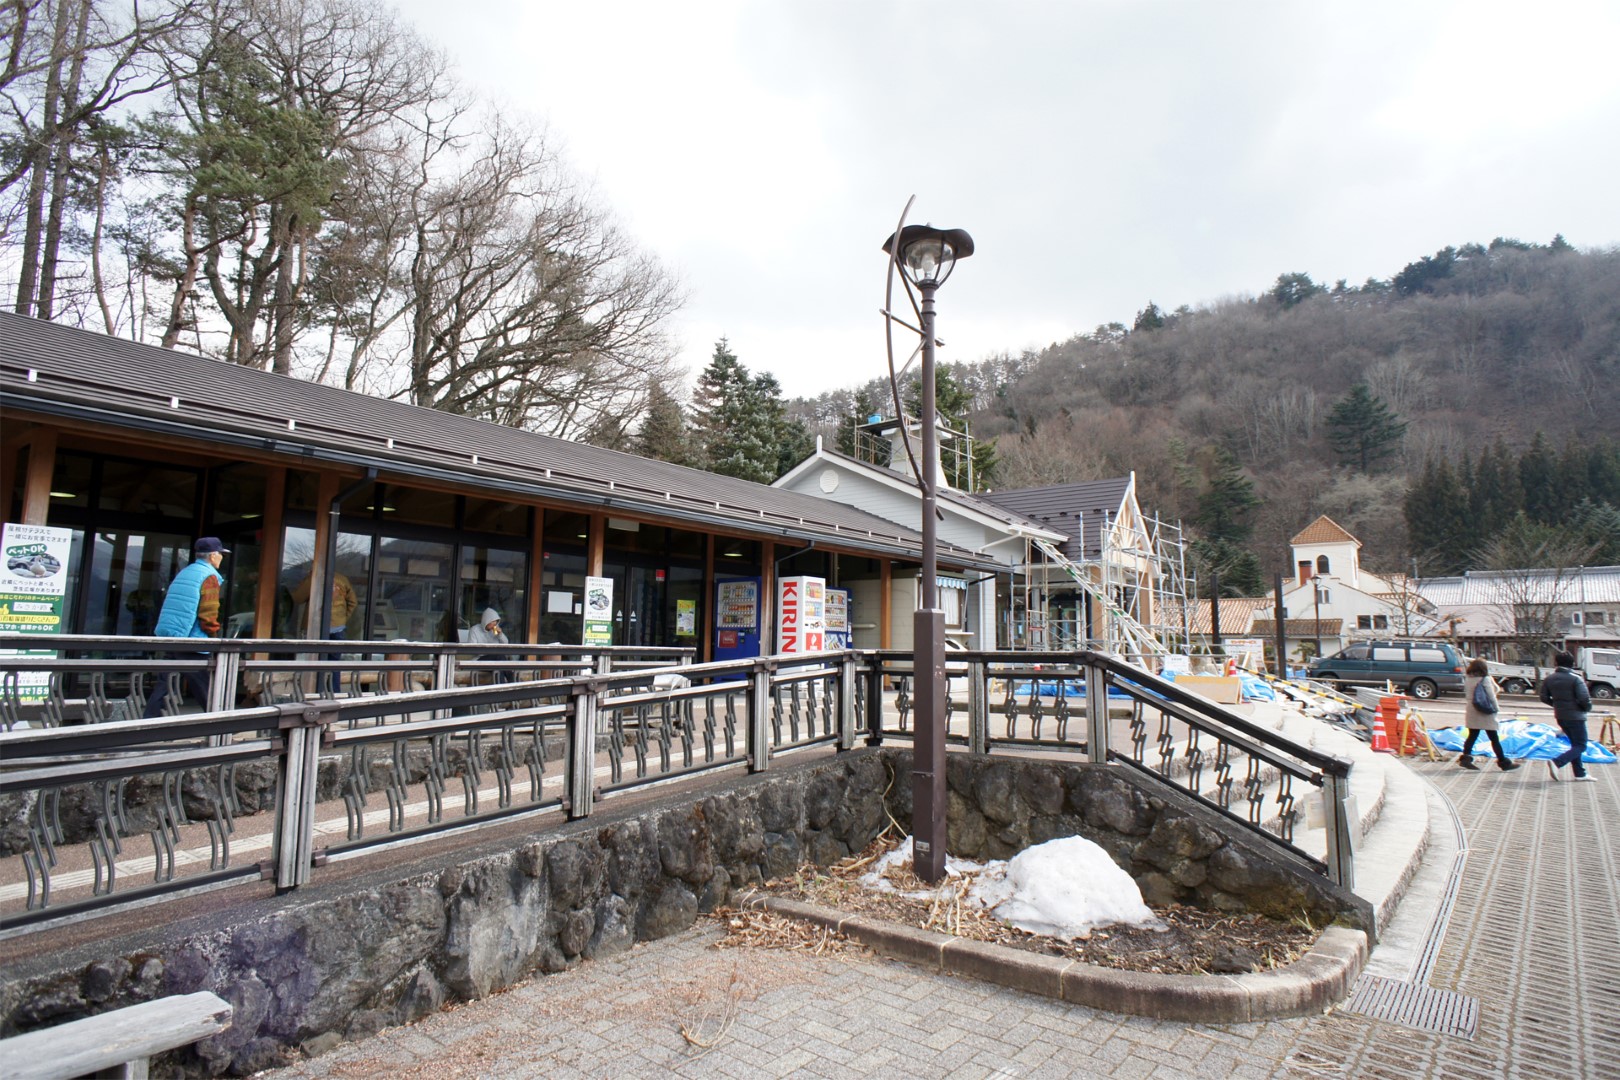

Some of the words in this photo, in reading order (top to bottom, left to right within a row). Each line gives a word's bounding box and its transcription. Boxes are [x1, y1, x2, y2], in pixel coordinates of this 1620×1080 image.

[8, 544, 45, 554] ペットOK
[782, 581, 797, 652] KIRIN
